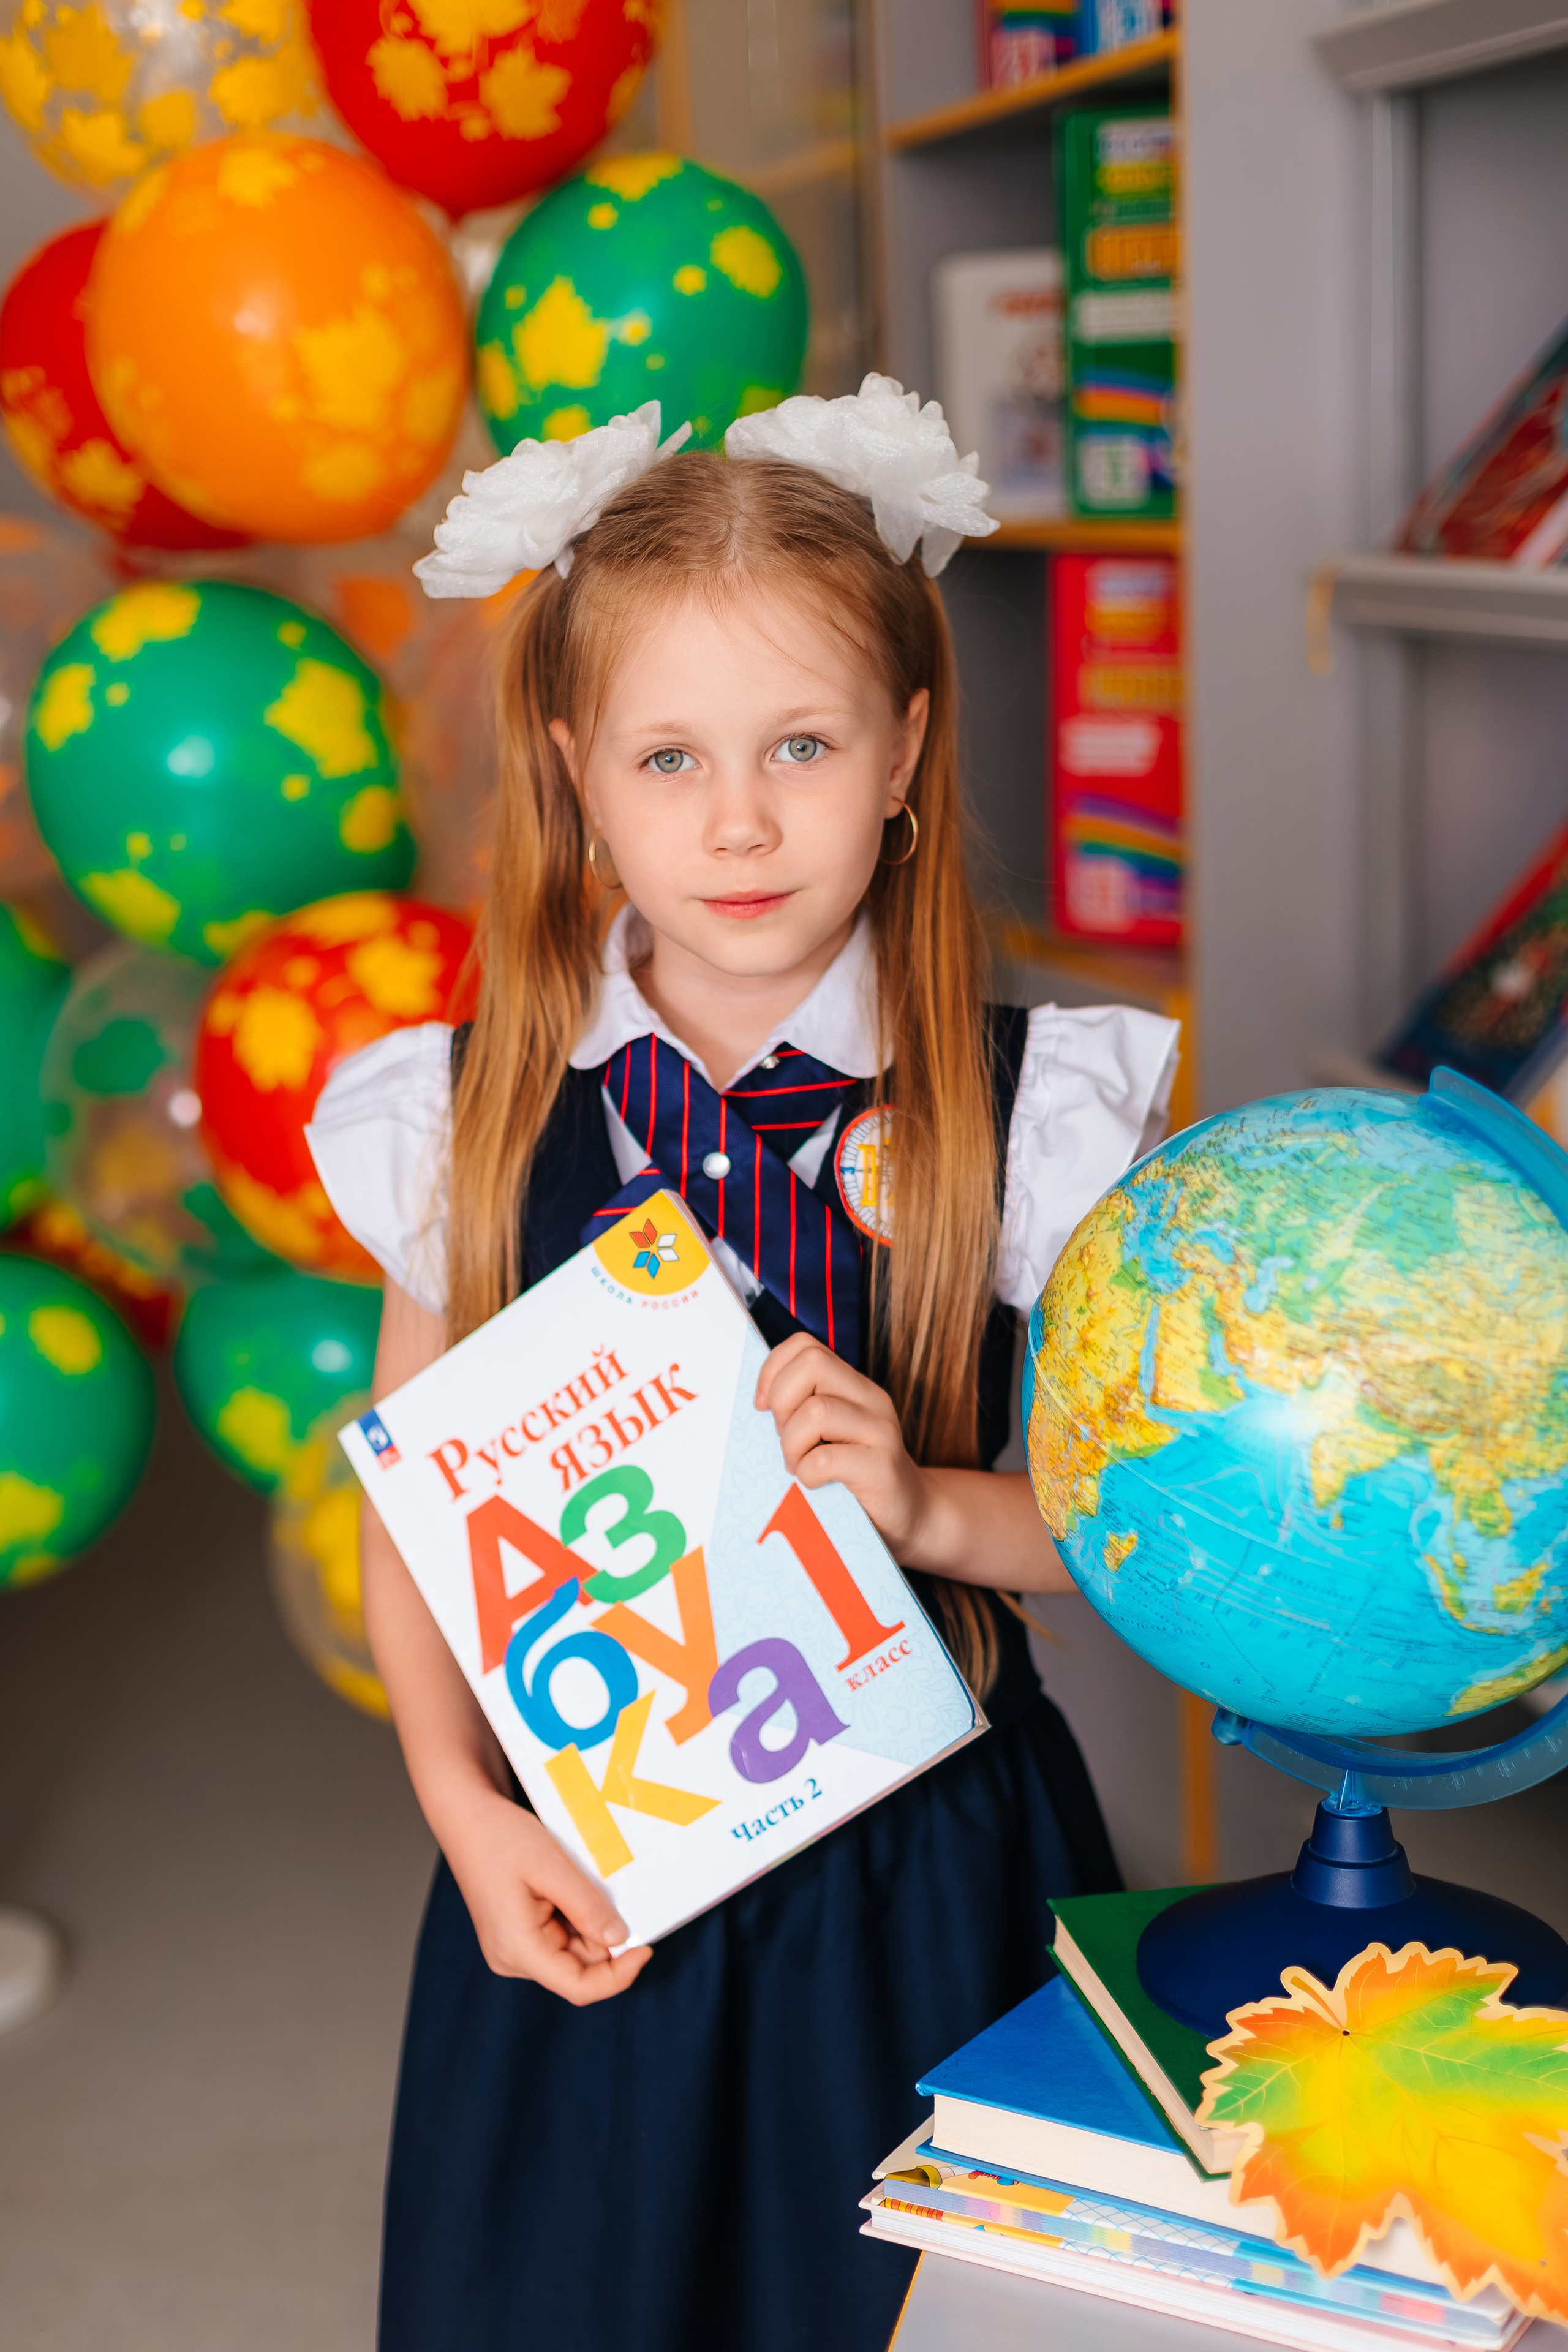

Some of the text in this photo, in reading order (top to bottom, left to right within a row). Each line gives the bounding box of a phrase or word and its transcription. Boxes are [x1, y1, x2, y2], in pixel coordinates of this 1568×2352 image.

[591, 1266, 699, 1310] ШКОЛА РОССИИ
[425, 1344, 630, 1502] Русский
[757, 1482, 906, 1672] 1
[845, 1640, 912, 1691] класс
[731, 1777, 823, 1841] Часть 2
